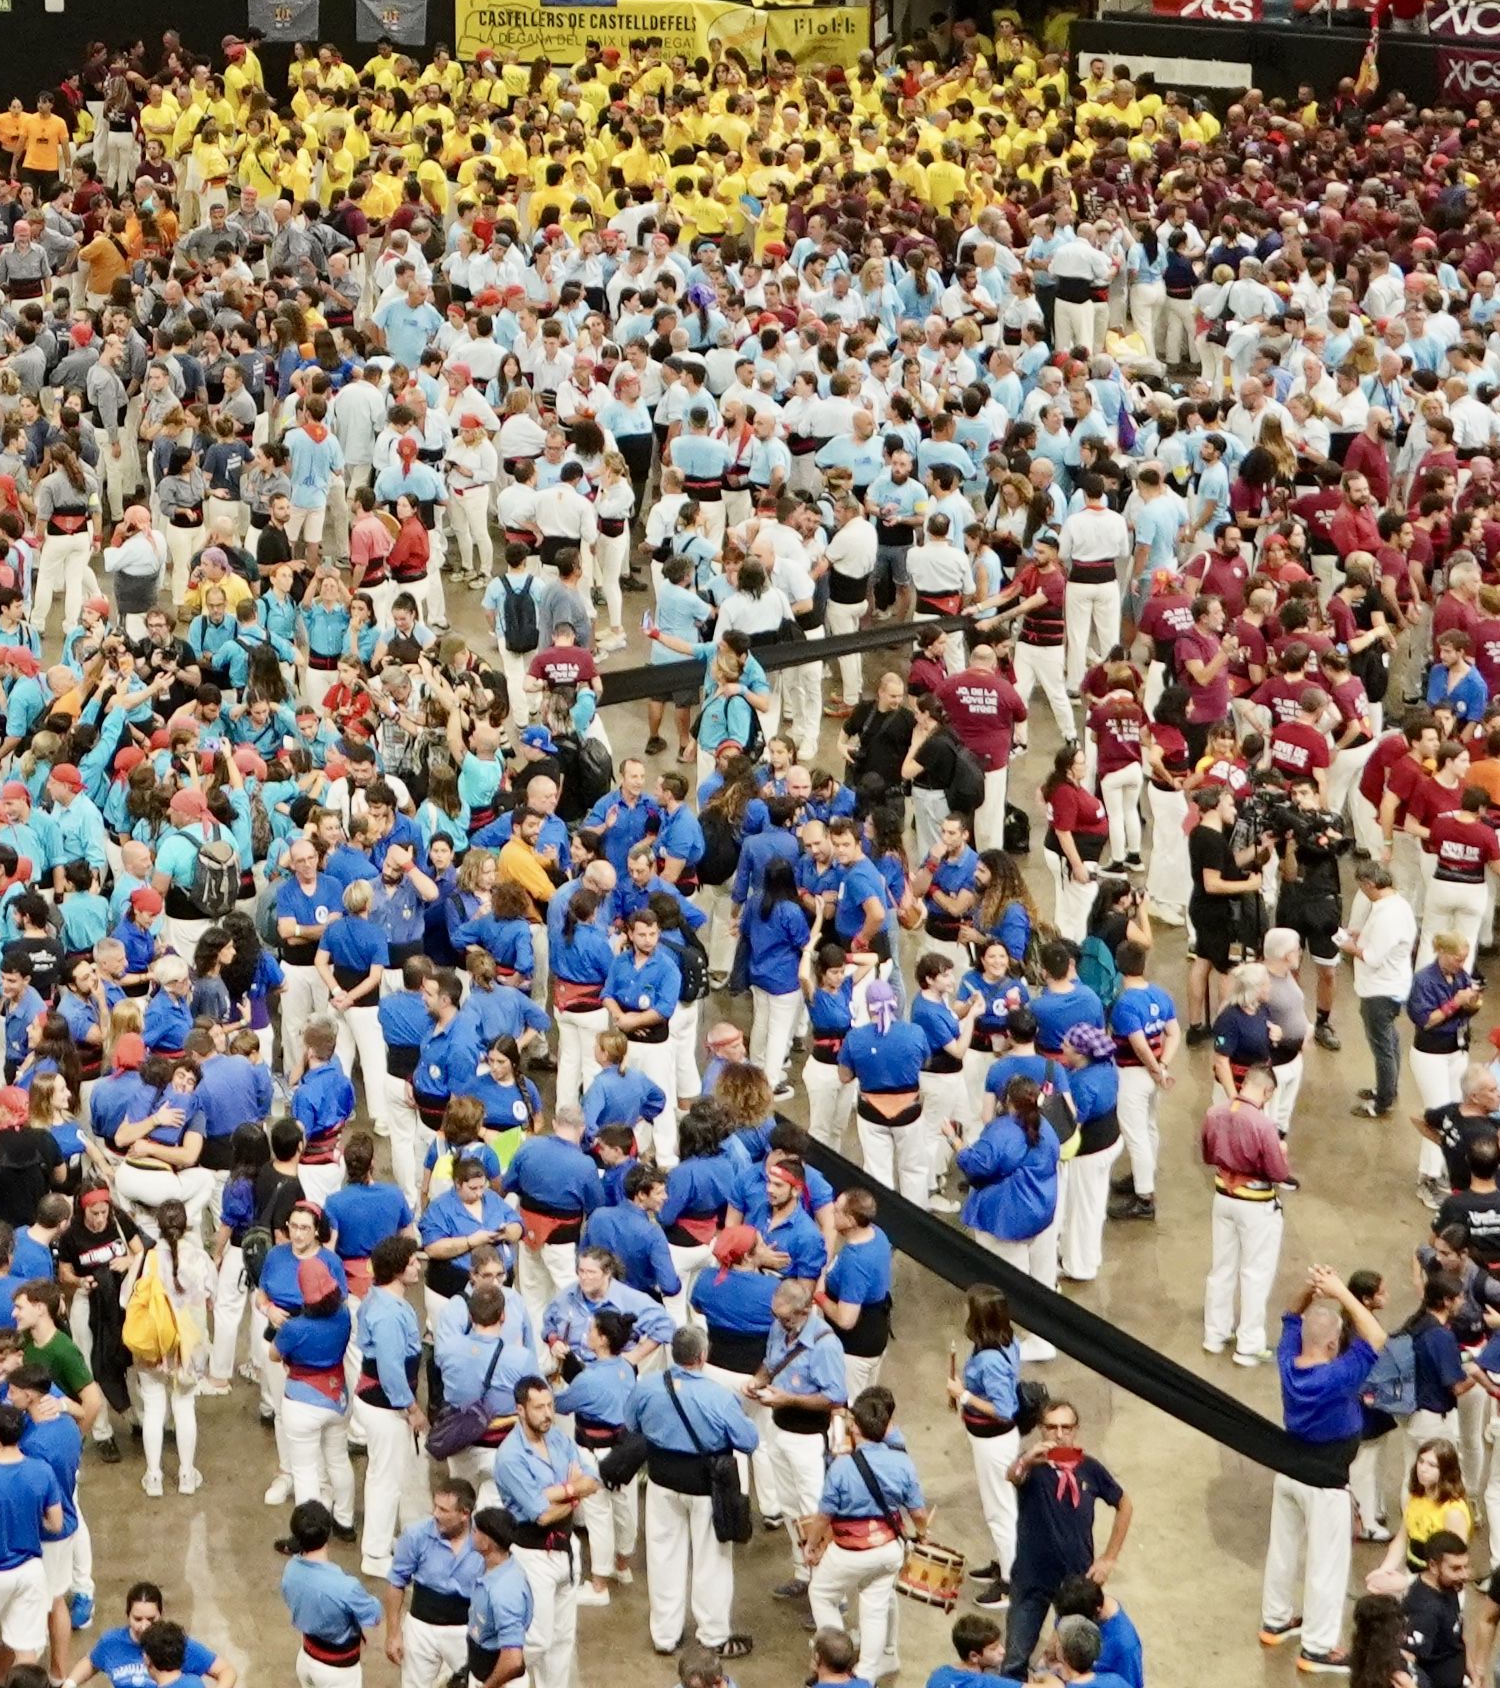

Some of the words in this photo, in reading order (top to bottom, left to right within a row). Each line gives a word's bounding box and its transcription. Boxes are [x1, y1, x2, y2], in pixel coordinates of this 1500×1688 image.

[478, 9, 564, 30] CASTELLERS
[568, 11, 587, 30] DE
[589, 12, 697, 33] CASTELLDEFELS
[478, 30, 494, 44] LA
[497, 31, 552, 47] DEGANA
[556, 33, 582, 48] DEL
